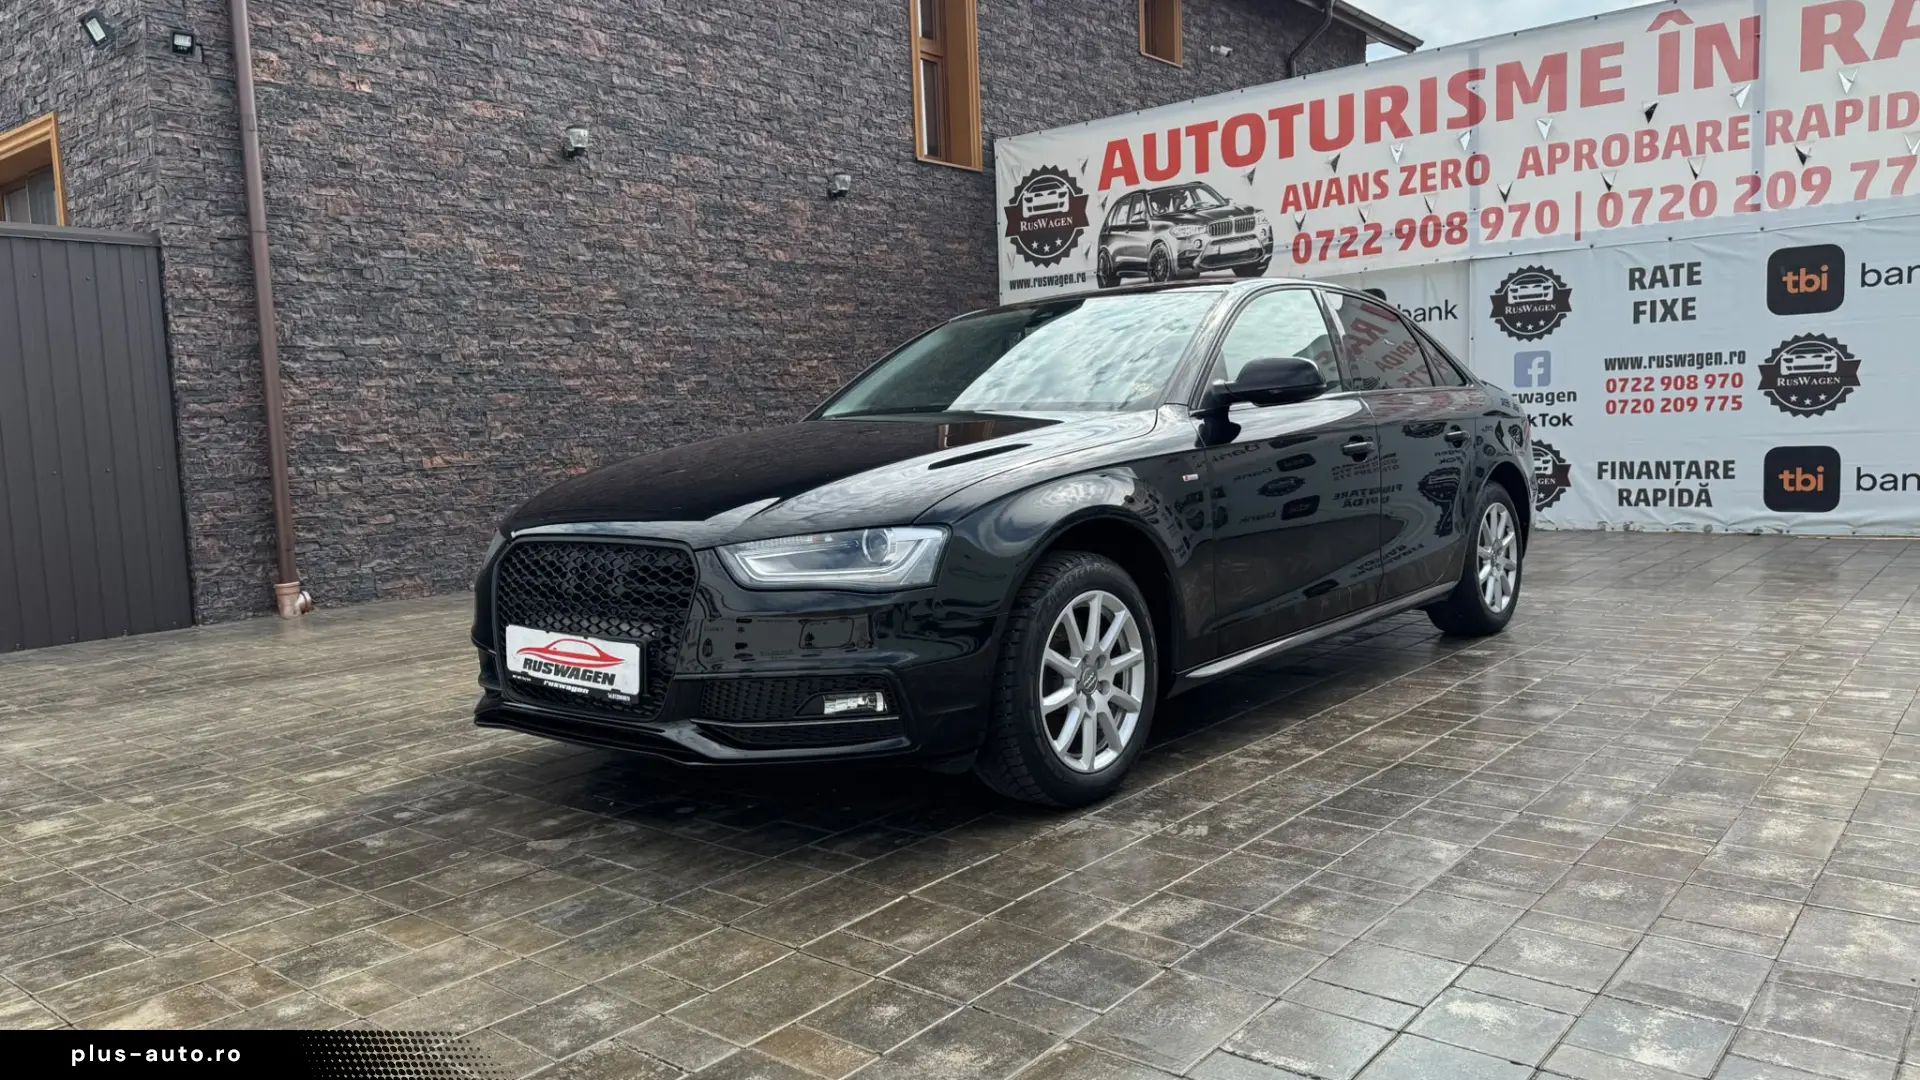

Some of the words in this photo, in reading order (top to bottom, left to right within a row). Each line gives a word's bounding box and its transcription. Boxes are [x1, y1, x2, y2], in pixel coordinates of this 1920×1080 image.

[1098, 41, 1625, 190] AUTOTURISME
[1646, 8, 1762, 96] ÎN
[1517, 115, 1751, 179] APROBARE
[1765, 91, 1920, 146] RAPID
[1280, 169, 1389, 214] AVANS
[1398, 153, 1490, 197] ZERO
[1292, 222, 1383, 265] 0722
[1394, 211, 1468, 252] 908
[1480, 199, 1560, 241] 970
[1597, 180, 1718, 228] 0720
[1734, 166, 1832, 213] 209
[1850, 155, 1918, 201] 77
[1009, 272, 1087, 291] www.ruswagen.ro
[1628, 261, 1702, 291] RATE
[1782, 264, 1829, 294] tbi
[1633, 296, 1697, 325] FIXE
[1604, 350, 1746, 371] www.ruswagen.ro
[1605, 376, 1655, 394] 0722
[1660, 374, 1699, 391] 908
[1704, 372, 1744, 389] 970
[1605, 398, 1655, 415] 0720
[1660, 396, 1699, 413] 209
[1704, 395, 1743, 412] 775
[1778, 465, 1825, 492] tbi
[523, 657, 616, 686] RUSWAGEN
